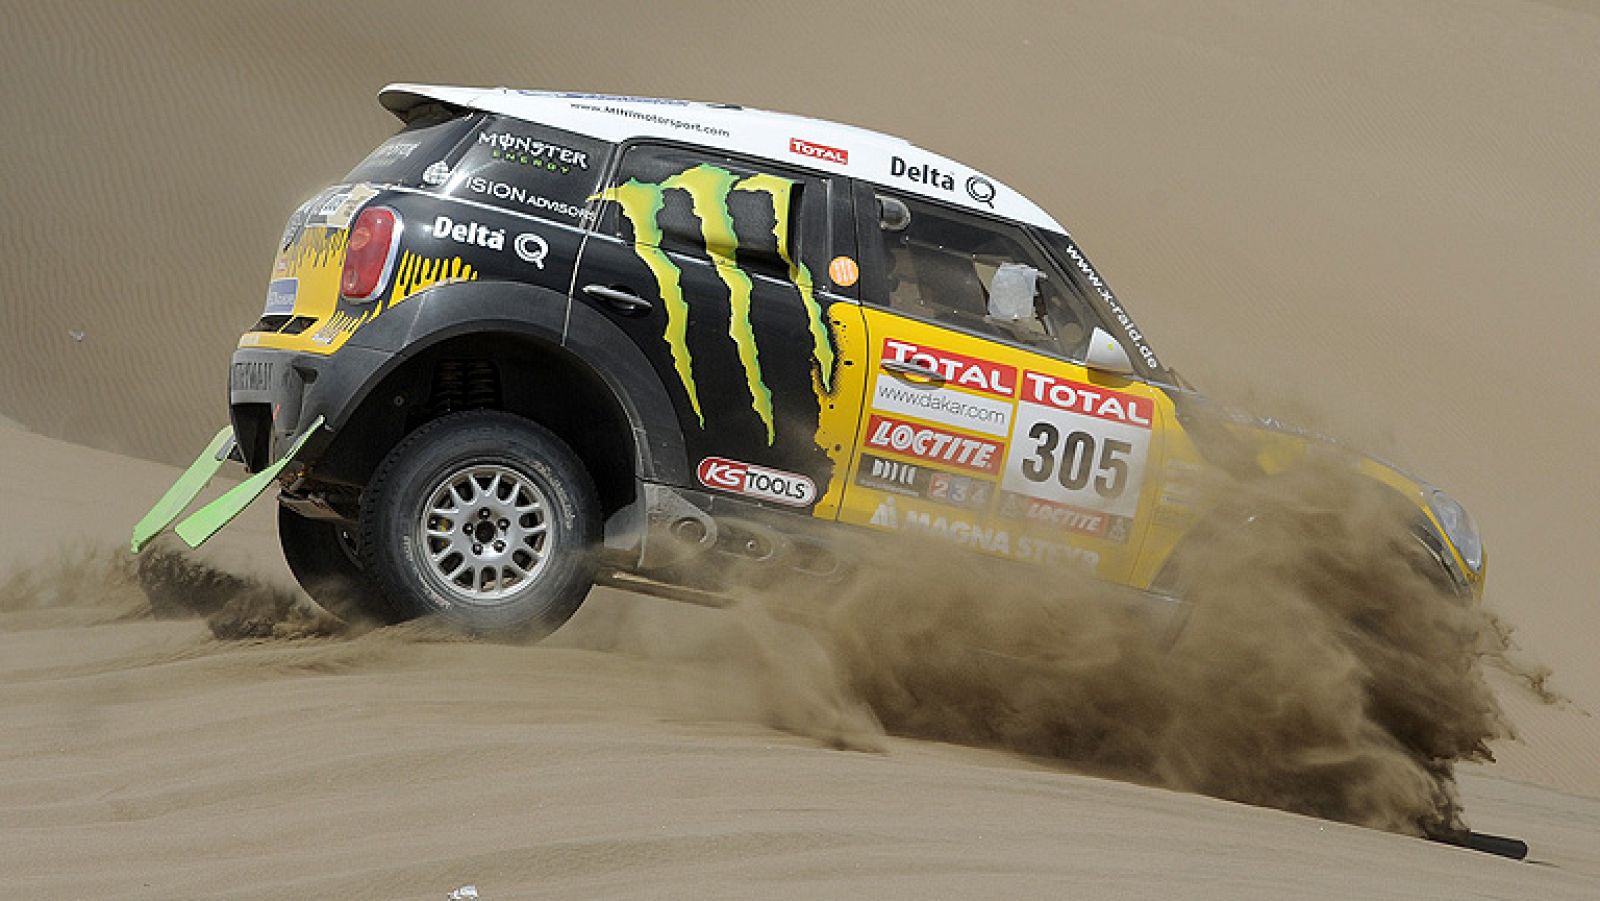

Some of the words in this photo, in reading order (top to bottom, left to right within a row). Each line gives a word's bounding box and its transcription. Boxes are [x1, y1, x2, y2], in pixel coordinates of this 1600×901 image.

[793, 140, 846, 164] TOTAL
[890, 156, 955, 192] Delta
[432, 216, 504, 251] Delta
[1066, 245, 1157, 368] www.x-raid.de
[887, 341, 1013, 394] TOTAL
[1026, 372, 1149, 424] TOTAL
[870, 421, 996, 468] LOCTITE
[1022, 422, 1132, 498] 305
[705, 462, 747, 486] KS
[746, 471, 805, 499] TOOLS
